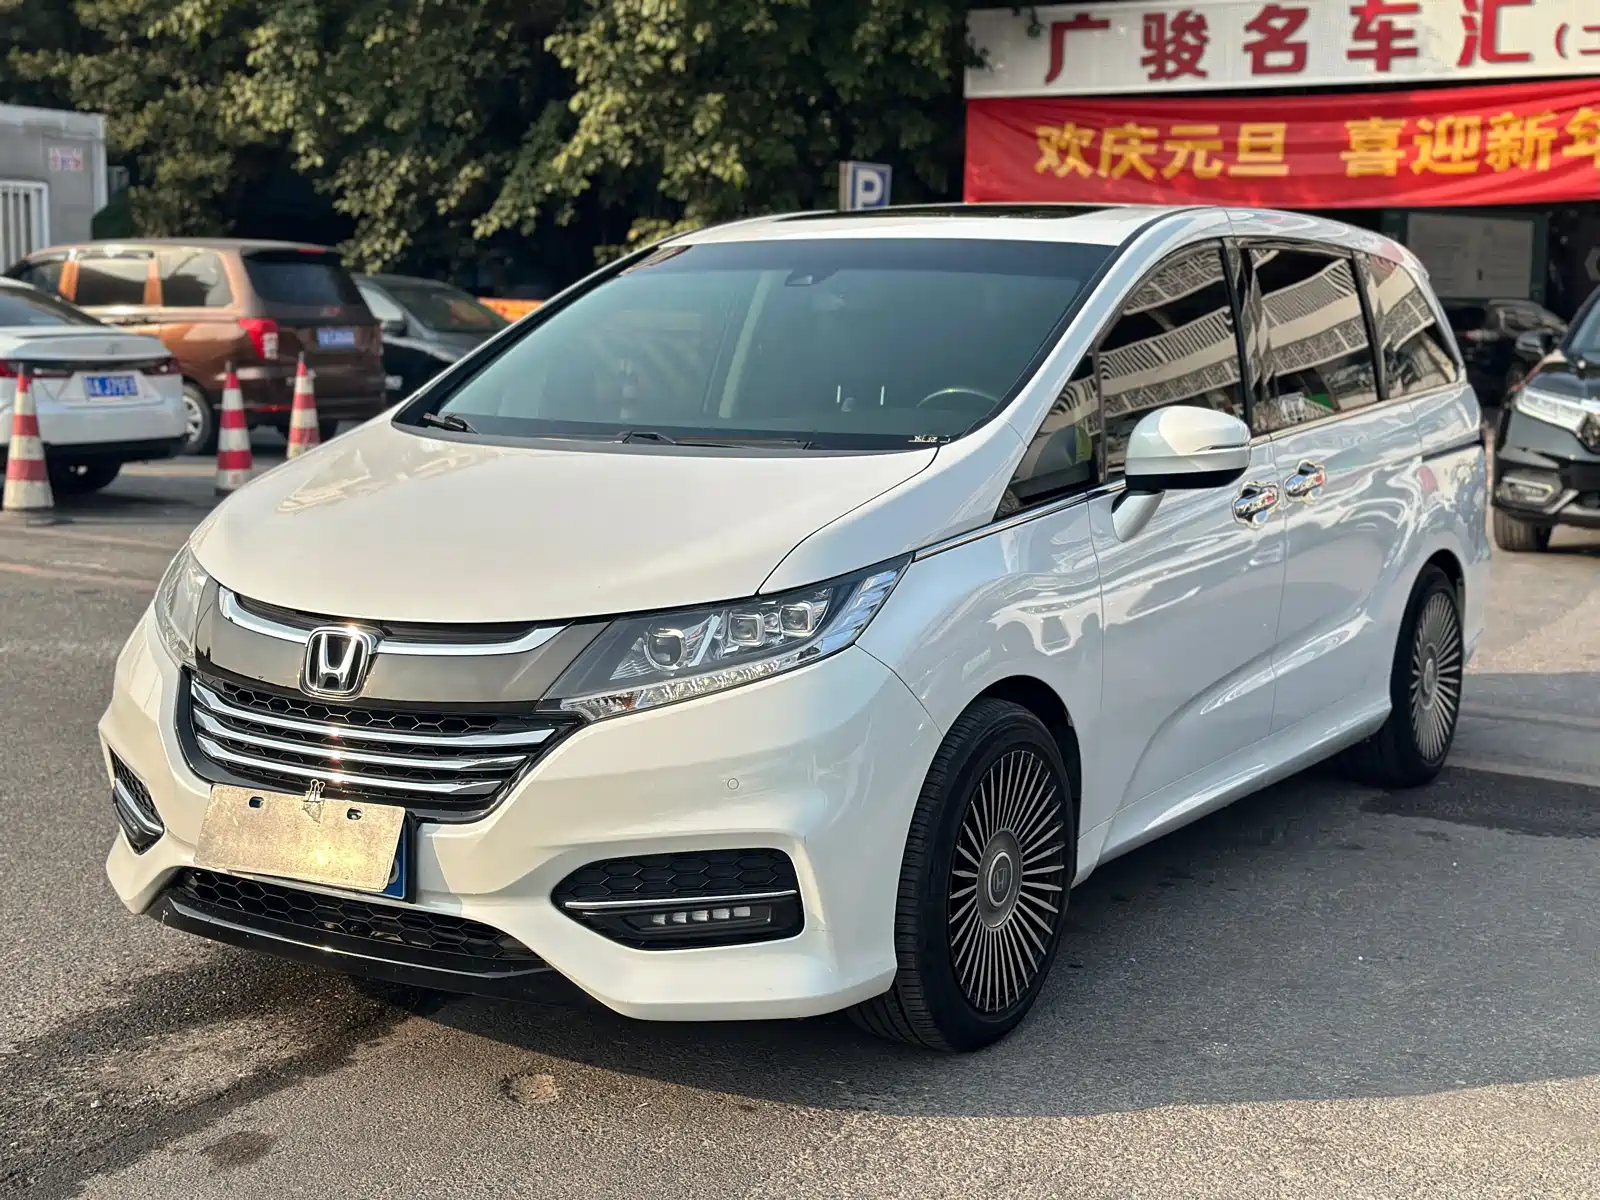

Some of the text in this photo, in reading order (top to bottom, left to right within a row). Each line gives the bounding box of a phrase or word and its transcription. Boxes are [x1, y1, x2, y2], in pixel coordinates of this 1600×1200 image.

[1034, 121, 1290, 179] 欢庆元旦
[855, 169, 884, 209] P
